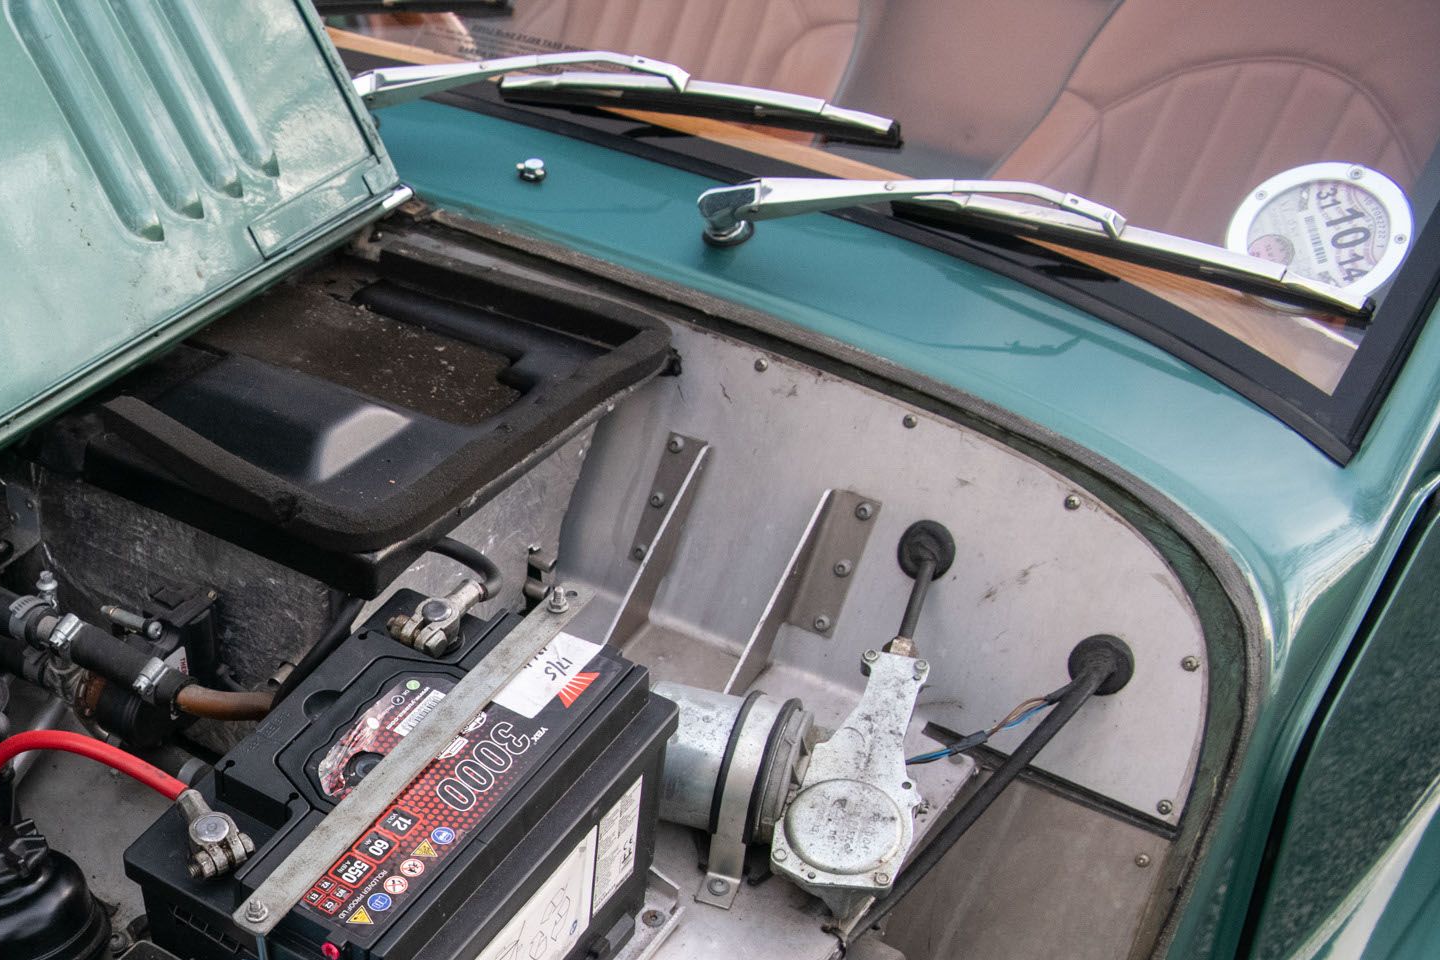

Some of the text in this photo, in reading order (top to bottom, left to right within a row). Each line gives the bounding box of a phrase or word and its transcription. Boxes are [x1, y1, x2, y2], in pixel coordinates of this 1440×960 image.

[1317, 186, 1371, 281] 31 10 14
[386, 686, 430, 730] www.yuasa.com
[530, 726, 548, 742] YBX
[436, 721, 530, 812] 3000
[391, 816, 412, 831] 12
[368, 839, 389, 856] 60
[341, 860, 369, 883] 550
[338, 869, 388, 919] ROLLOVER PROOF LID
